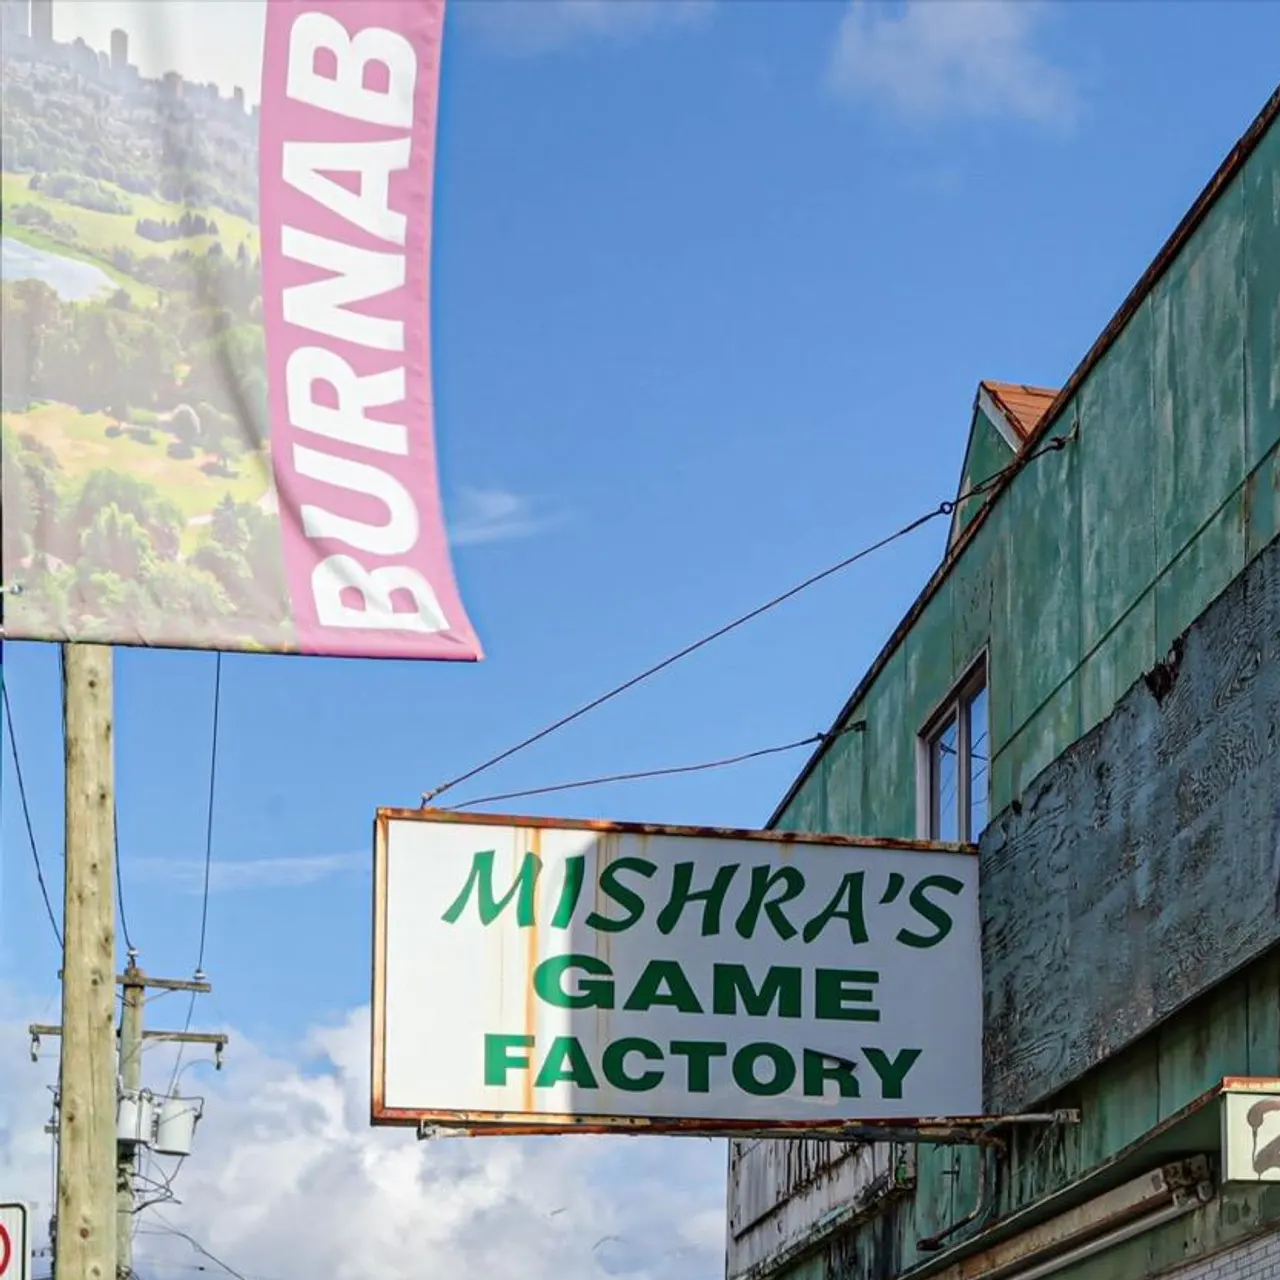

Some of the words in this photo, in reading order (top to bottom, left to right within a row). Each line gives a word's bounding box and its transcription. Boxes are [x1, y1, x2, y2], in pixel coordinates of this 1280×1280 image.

[281, 12, 450, 635] BURNAB
[441, 849, 964, 948] MISHRA'S
[533, 954, 881, 1022] GAME
[484, 1033, 922, 1099] FACTORY
